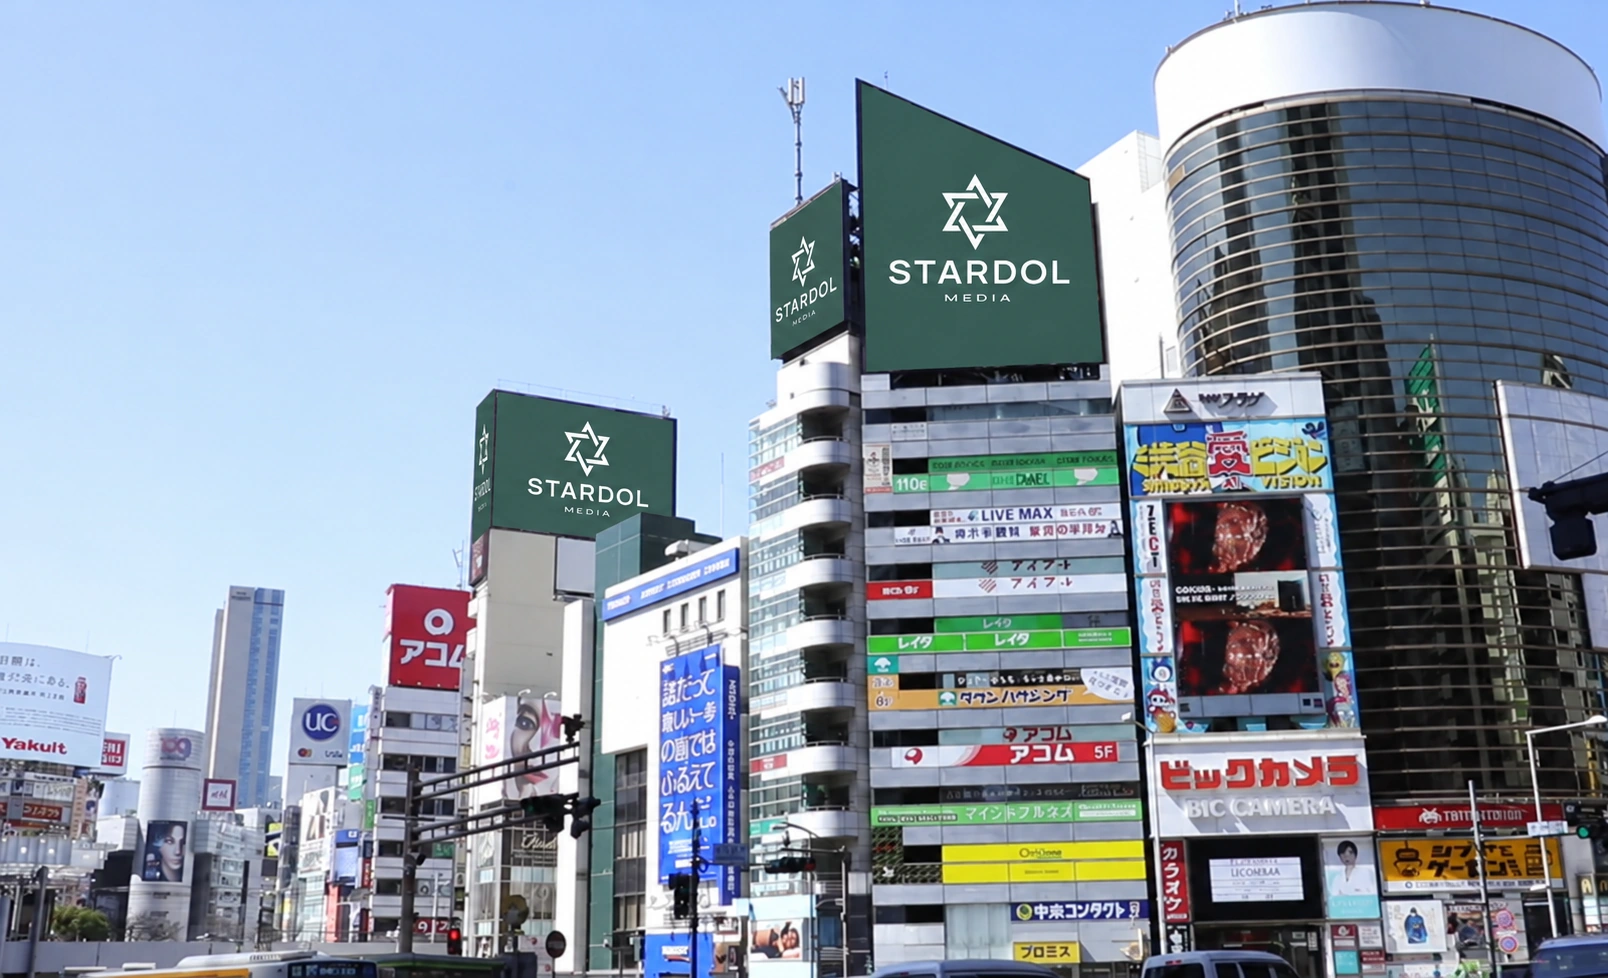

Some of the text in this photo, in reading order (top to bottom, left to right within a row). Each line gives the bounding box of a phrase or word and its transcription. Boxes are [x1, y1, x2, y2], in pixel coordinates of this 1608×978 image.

[889, 260, 1070, 285] STARDOL
[775, 277, 837, 323] STARDOL
[944, 293, 1011, 303] MEDIA
[792, 310, 816, 326] MEDIA
[527, 477, 649, 508] STARDOL
[565, 506, 611, 518] MEDIA
[981, 508, 1014, 522] LIVE
[1018, 507, 1053, 520] MAX
[305, 712, 337, 732] UC
[1, 736, 68, 756] Yakult
[1010, 744, 1113, 764] アコム 5F
[1160, 755, 1360, 790] ビックカメラ
[1185, 796, 1337, 819] BIC CAMERA
[1020, 945, 1071, 959] プロミス
